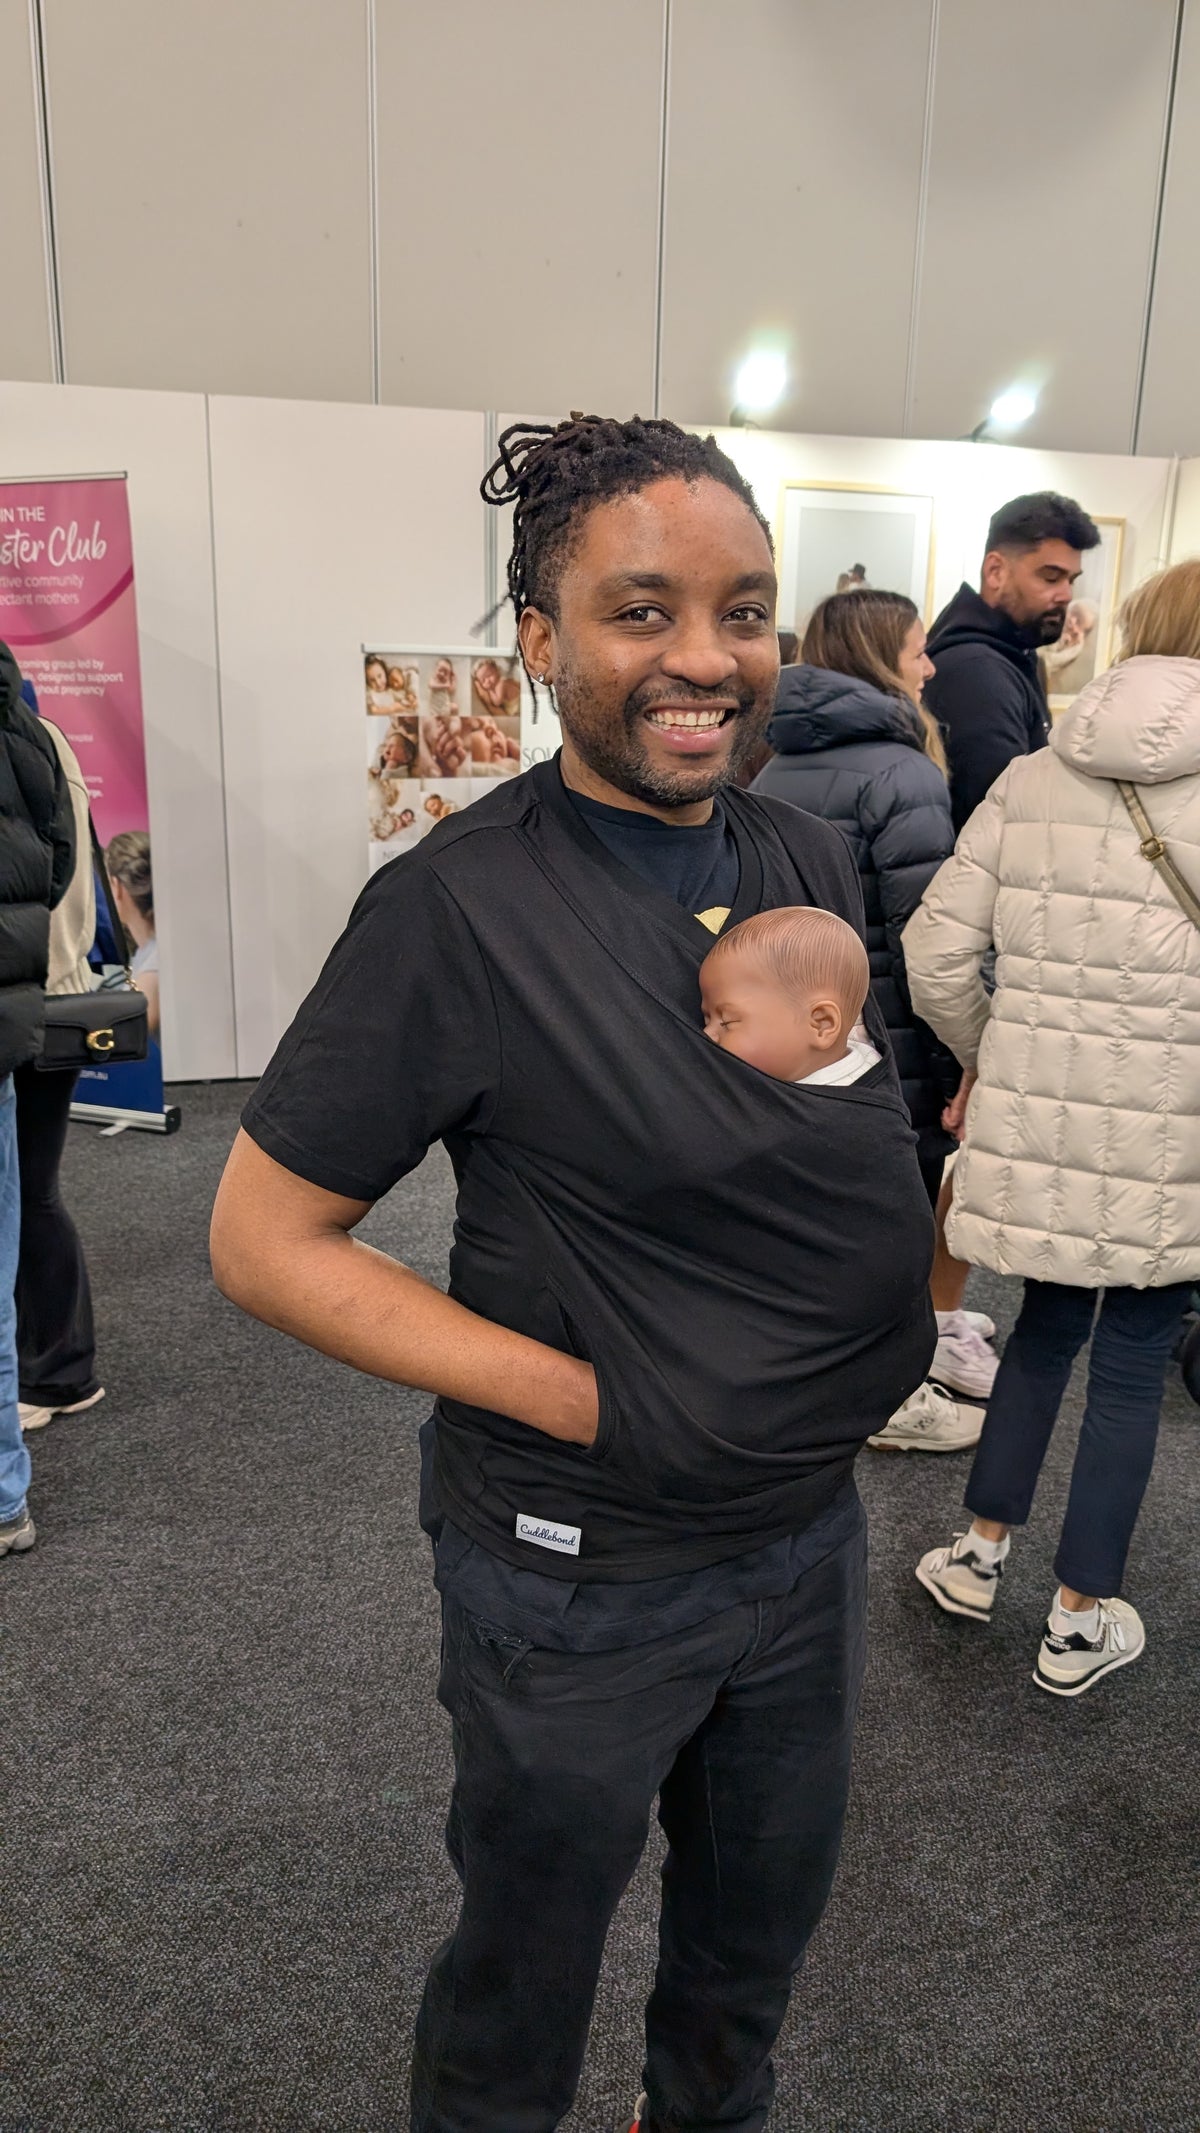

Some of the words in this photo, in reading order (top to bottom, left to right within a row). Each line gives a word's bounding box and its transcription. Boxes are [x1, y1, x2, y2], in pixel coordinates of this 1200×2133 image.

[17, 506, 45, 522] THE
[48, 520, 107, 567] Club
[24, 574, 84, 590] community
[34, 592, 80, 605] mothers
[51, 660, 76, 671] group
[92, 659, 104, 671] by
[87, 671, 123, 684] support
[520, 1523, 577, 1546] Cuddlebond
